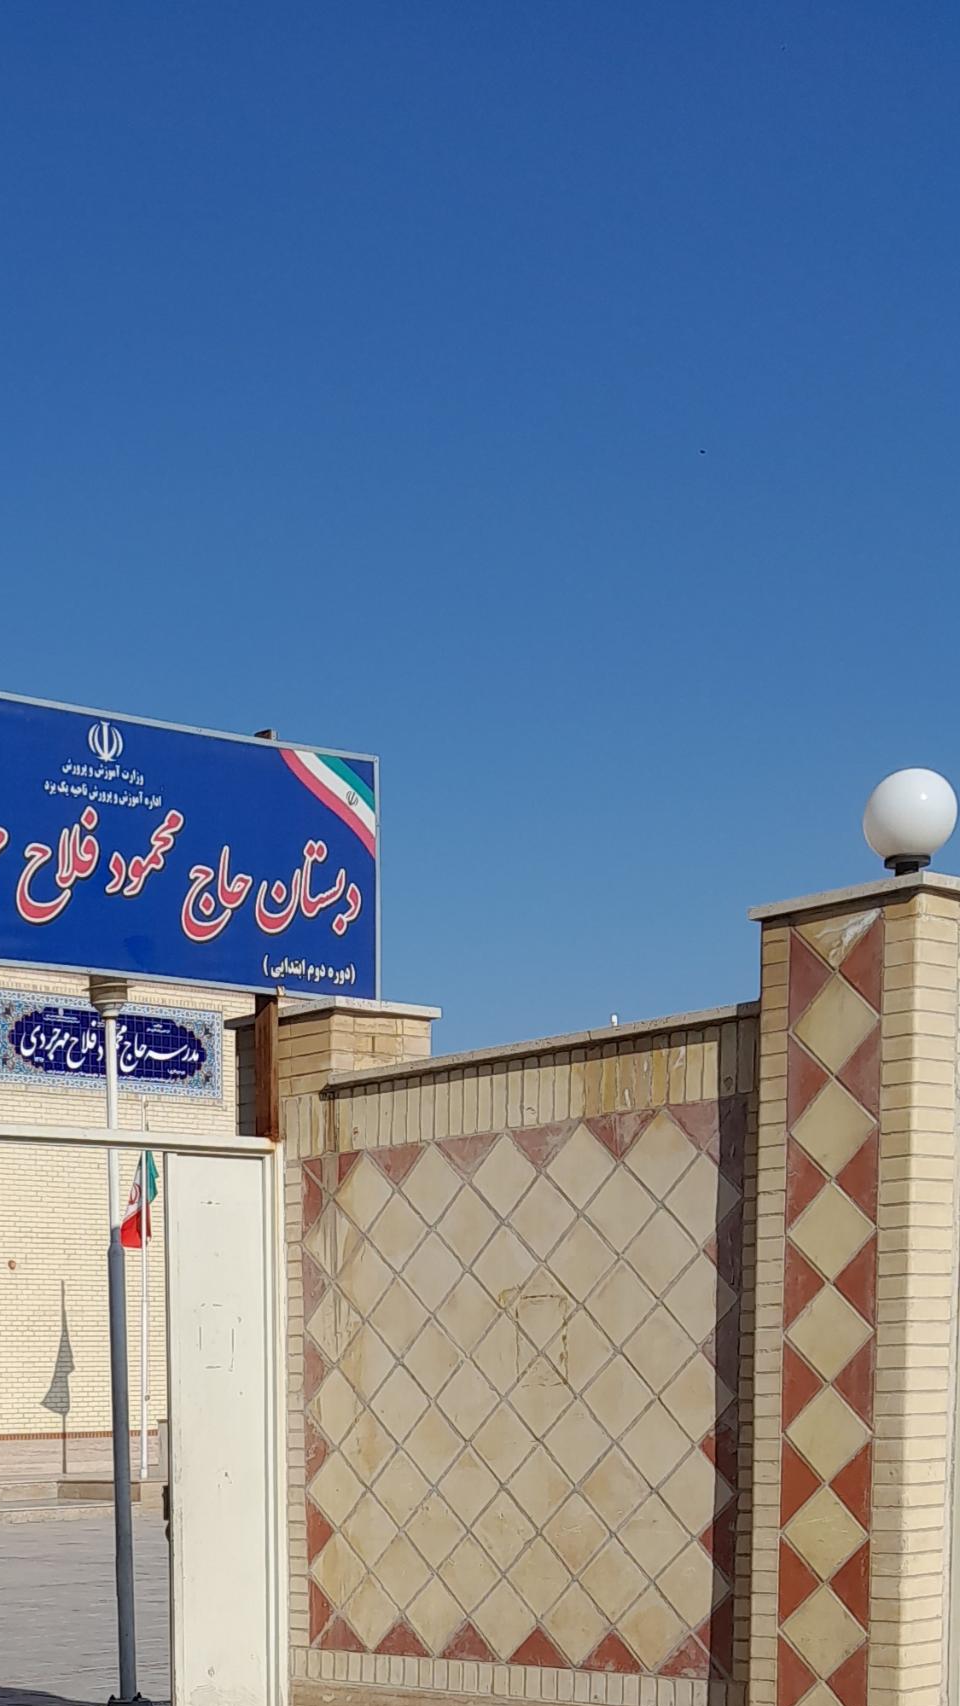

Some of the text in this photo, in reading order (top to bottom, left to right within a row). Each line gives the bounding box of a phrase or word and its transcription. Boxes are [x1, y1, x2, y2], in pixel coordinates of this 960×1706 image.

[62, 758, 144, 785] وزارت آموزش و پرورش
[44, 780, 161, 810] اداره آموزش و پرورش ناحیه یک یزد
[16, 806, 100, 923] فلاح
[105, 809, 184, 896] محمود
[181, 845, 253, 941] حاج
[255, 839, 362, 936] دبستان
[307, 964, 326, 982] دوم
[66, 1020, 97, 1069] فلاح
[120, 1032, 147, 1073] حاج
[144, 1044, 200, 1062] مدرسه
